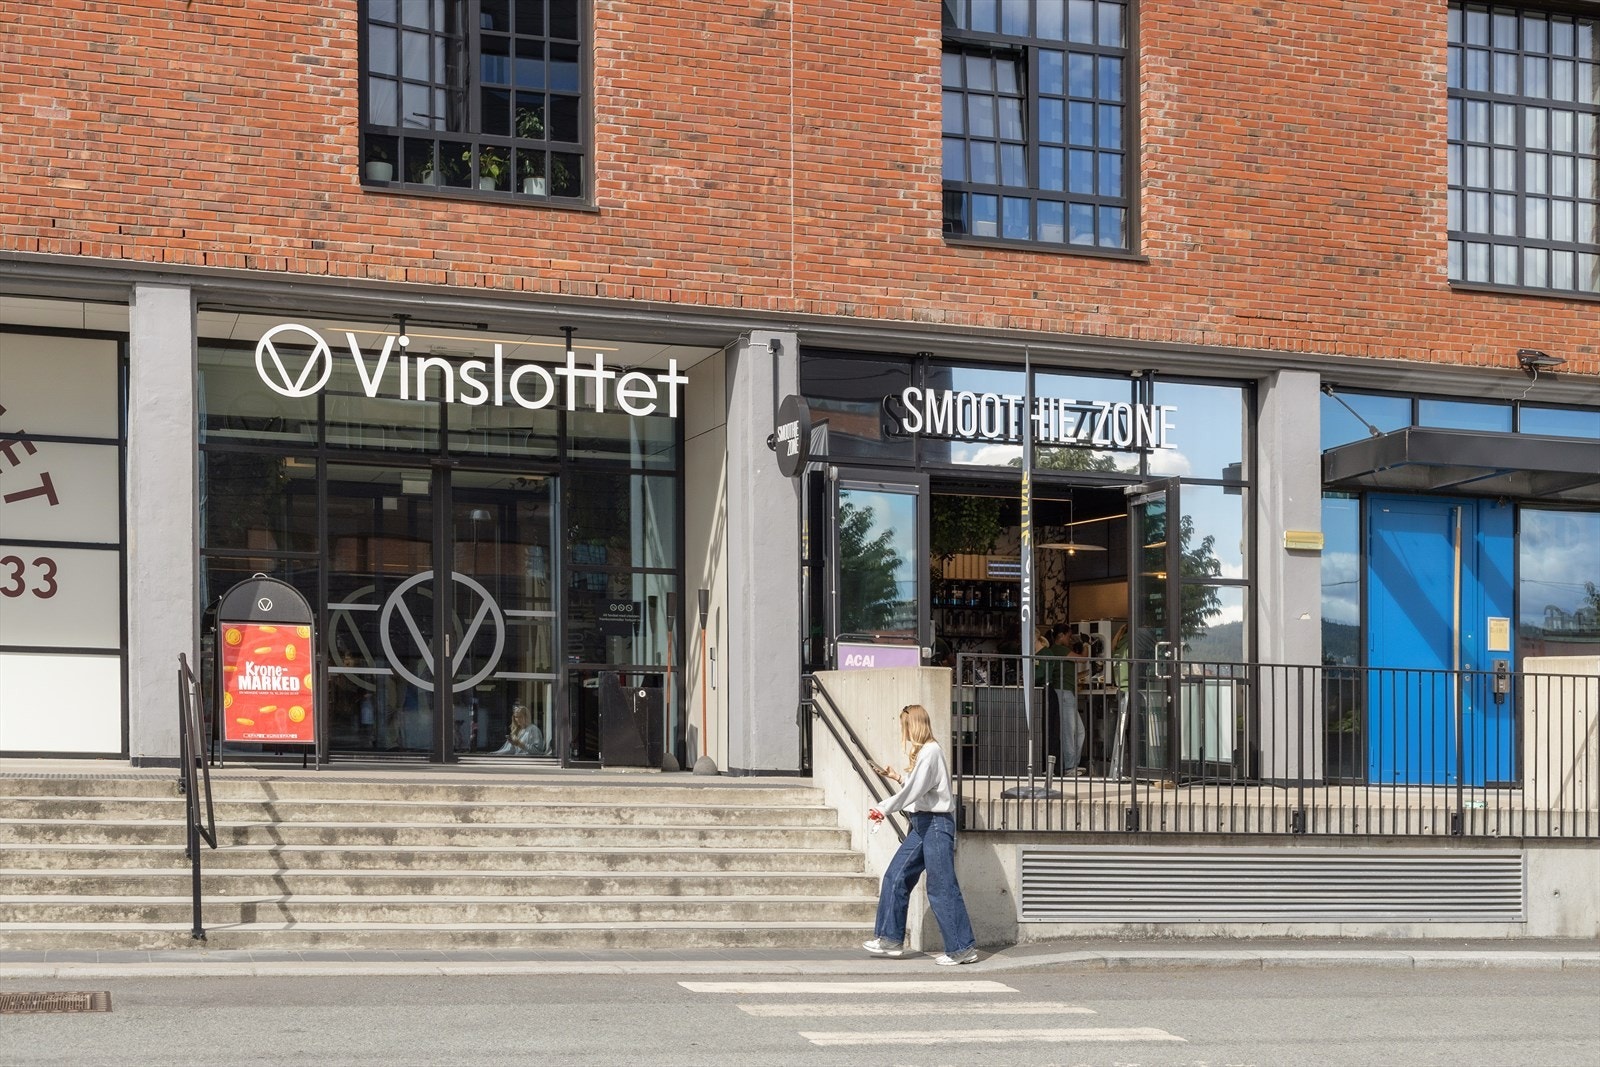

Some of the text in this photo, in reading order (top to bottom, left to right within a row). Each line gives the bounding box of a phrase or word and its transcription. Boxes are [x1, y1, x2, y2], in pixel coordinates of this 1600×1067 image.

[346, 332, 689, 418] Vinslottet
[902, 386, 1178, 449] SMOOTHIE ZONE
[777, 420, 799, 442] SMOOTHIE
[787, 436, 799, 456] ZONE
[245, 660, 288, 677] Krone-
[844, 654, 875, 667] ACAI
[237, 675, 300, 691] MARKED
